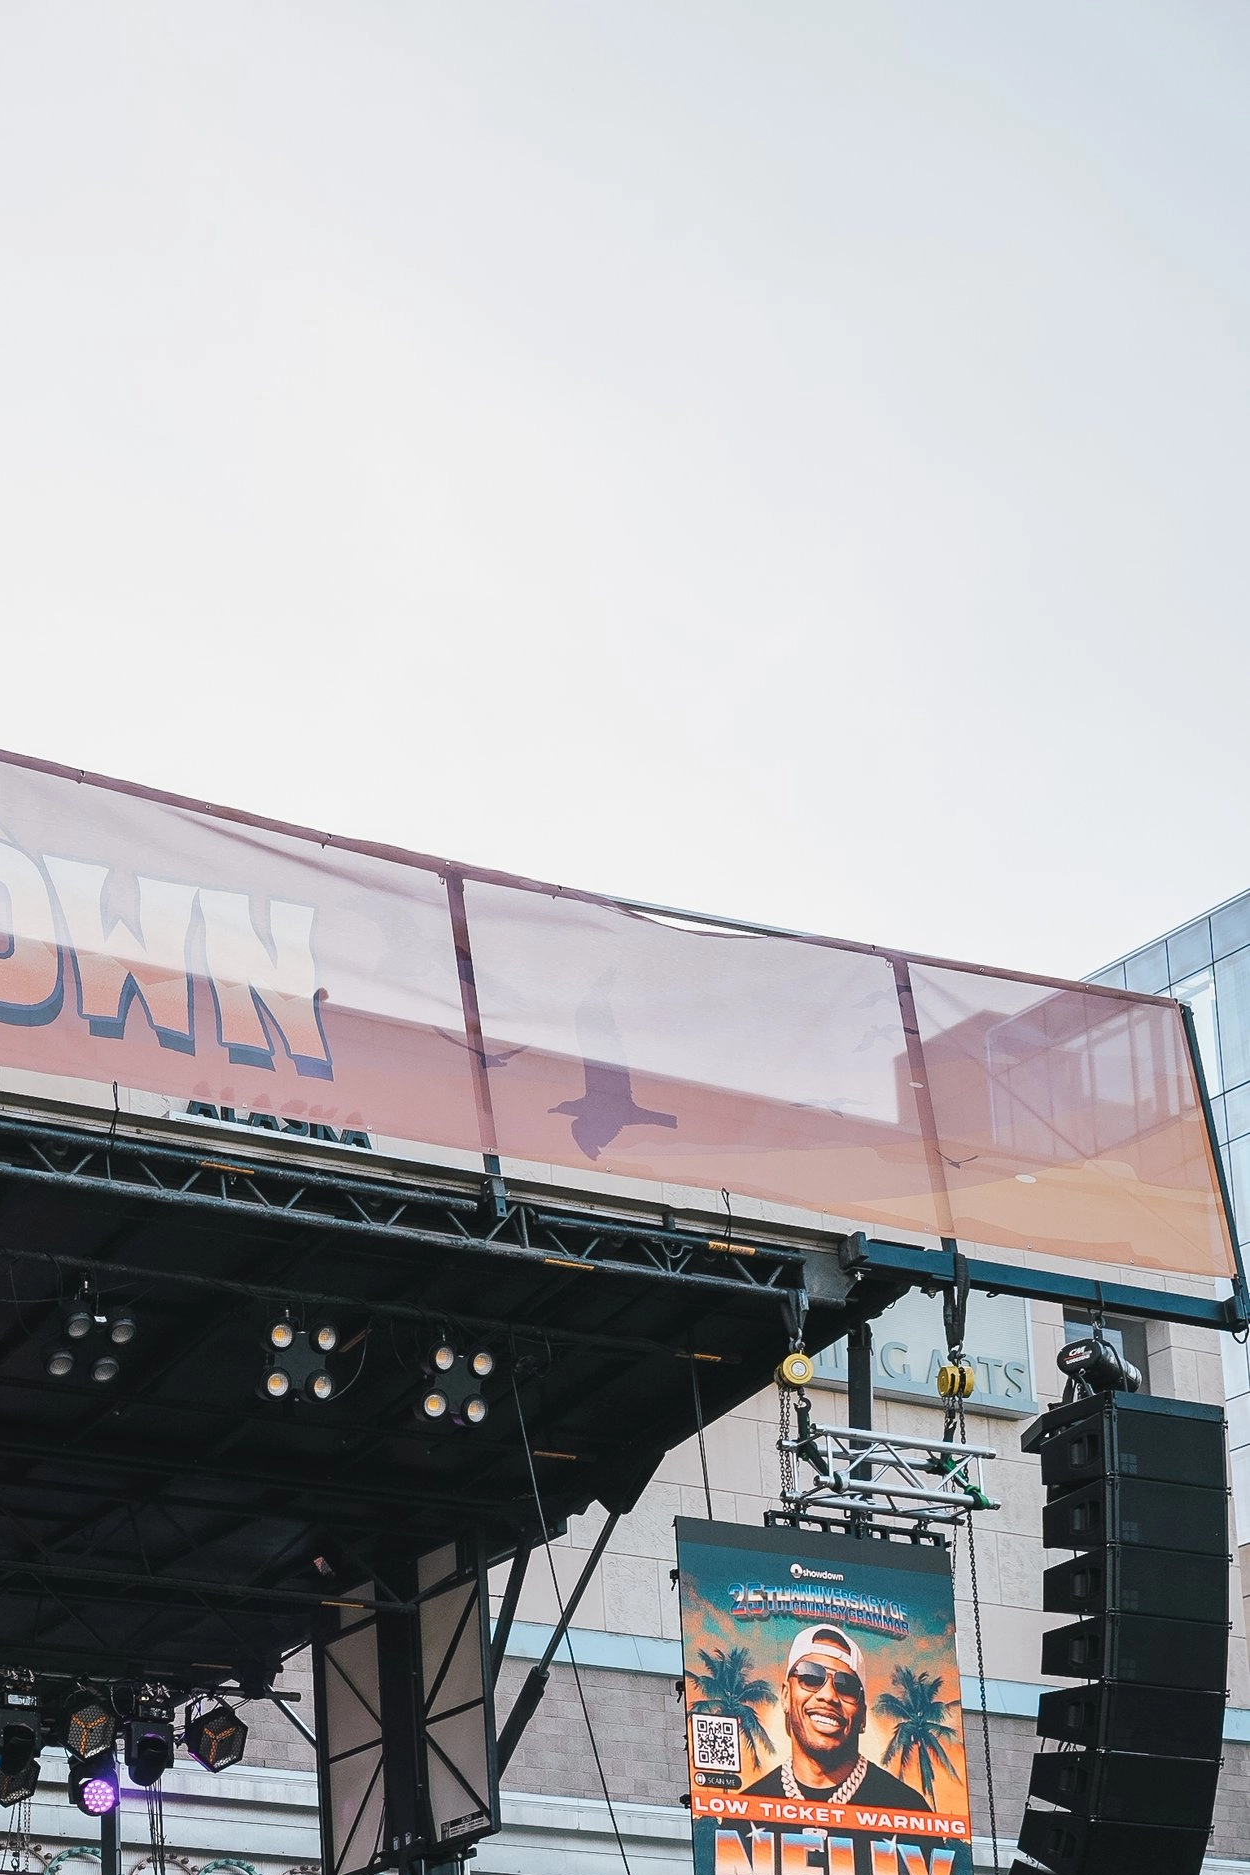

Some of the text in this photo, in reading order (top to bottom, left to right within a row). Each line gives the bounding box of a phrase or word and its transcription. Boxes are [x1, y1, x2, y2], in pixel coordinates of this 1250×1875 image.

[802, 1568, 844, 1581] showdown
[728, 1581, 908, 1621] 25TH ANNIVERSARY OF
[791, 1601, 910, 1634] COUNTRY GRAMMAR
[707, 1776, 735, 1786] SCAN ME
[694, 1796, 966, 1835] LOW TICKET WARNING
